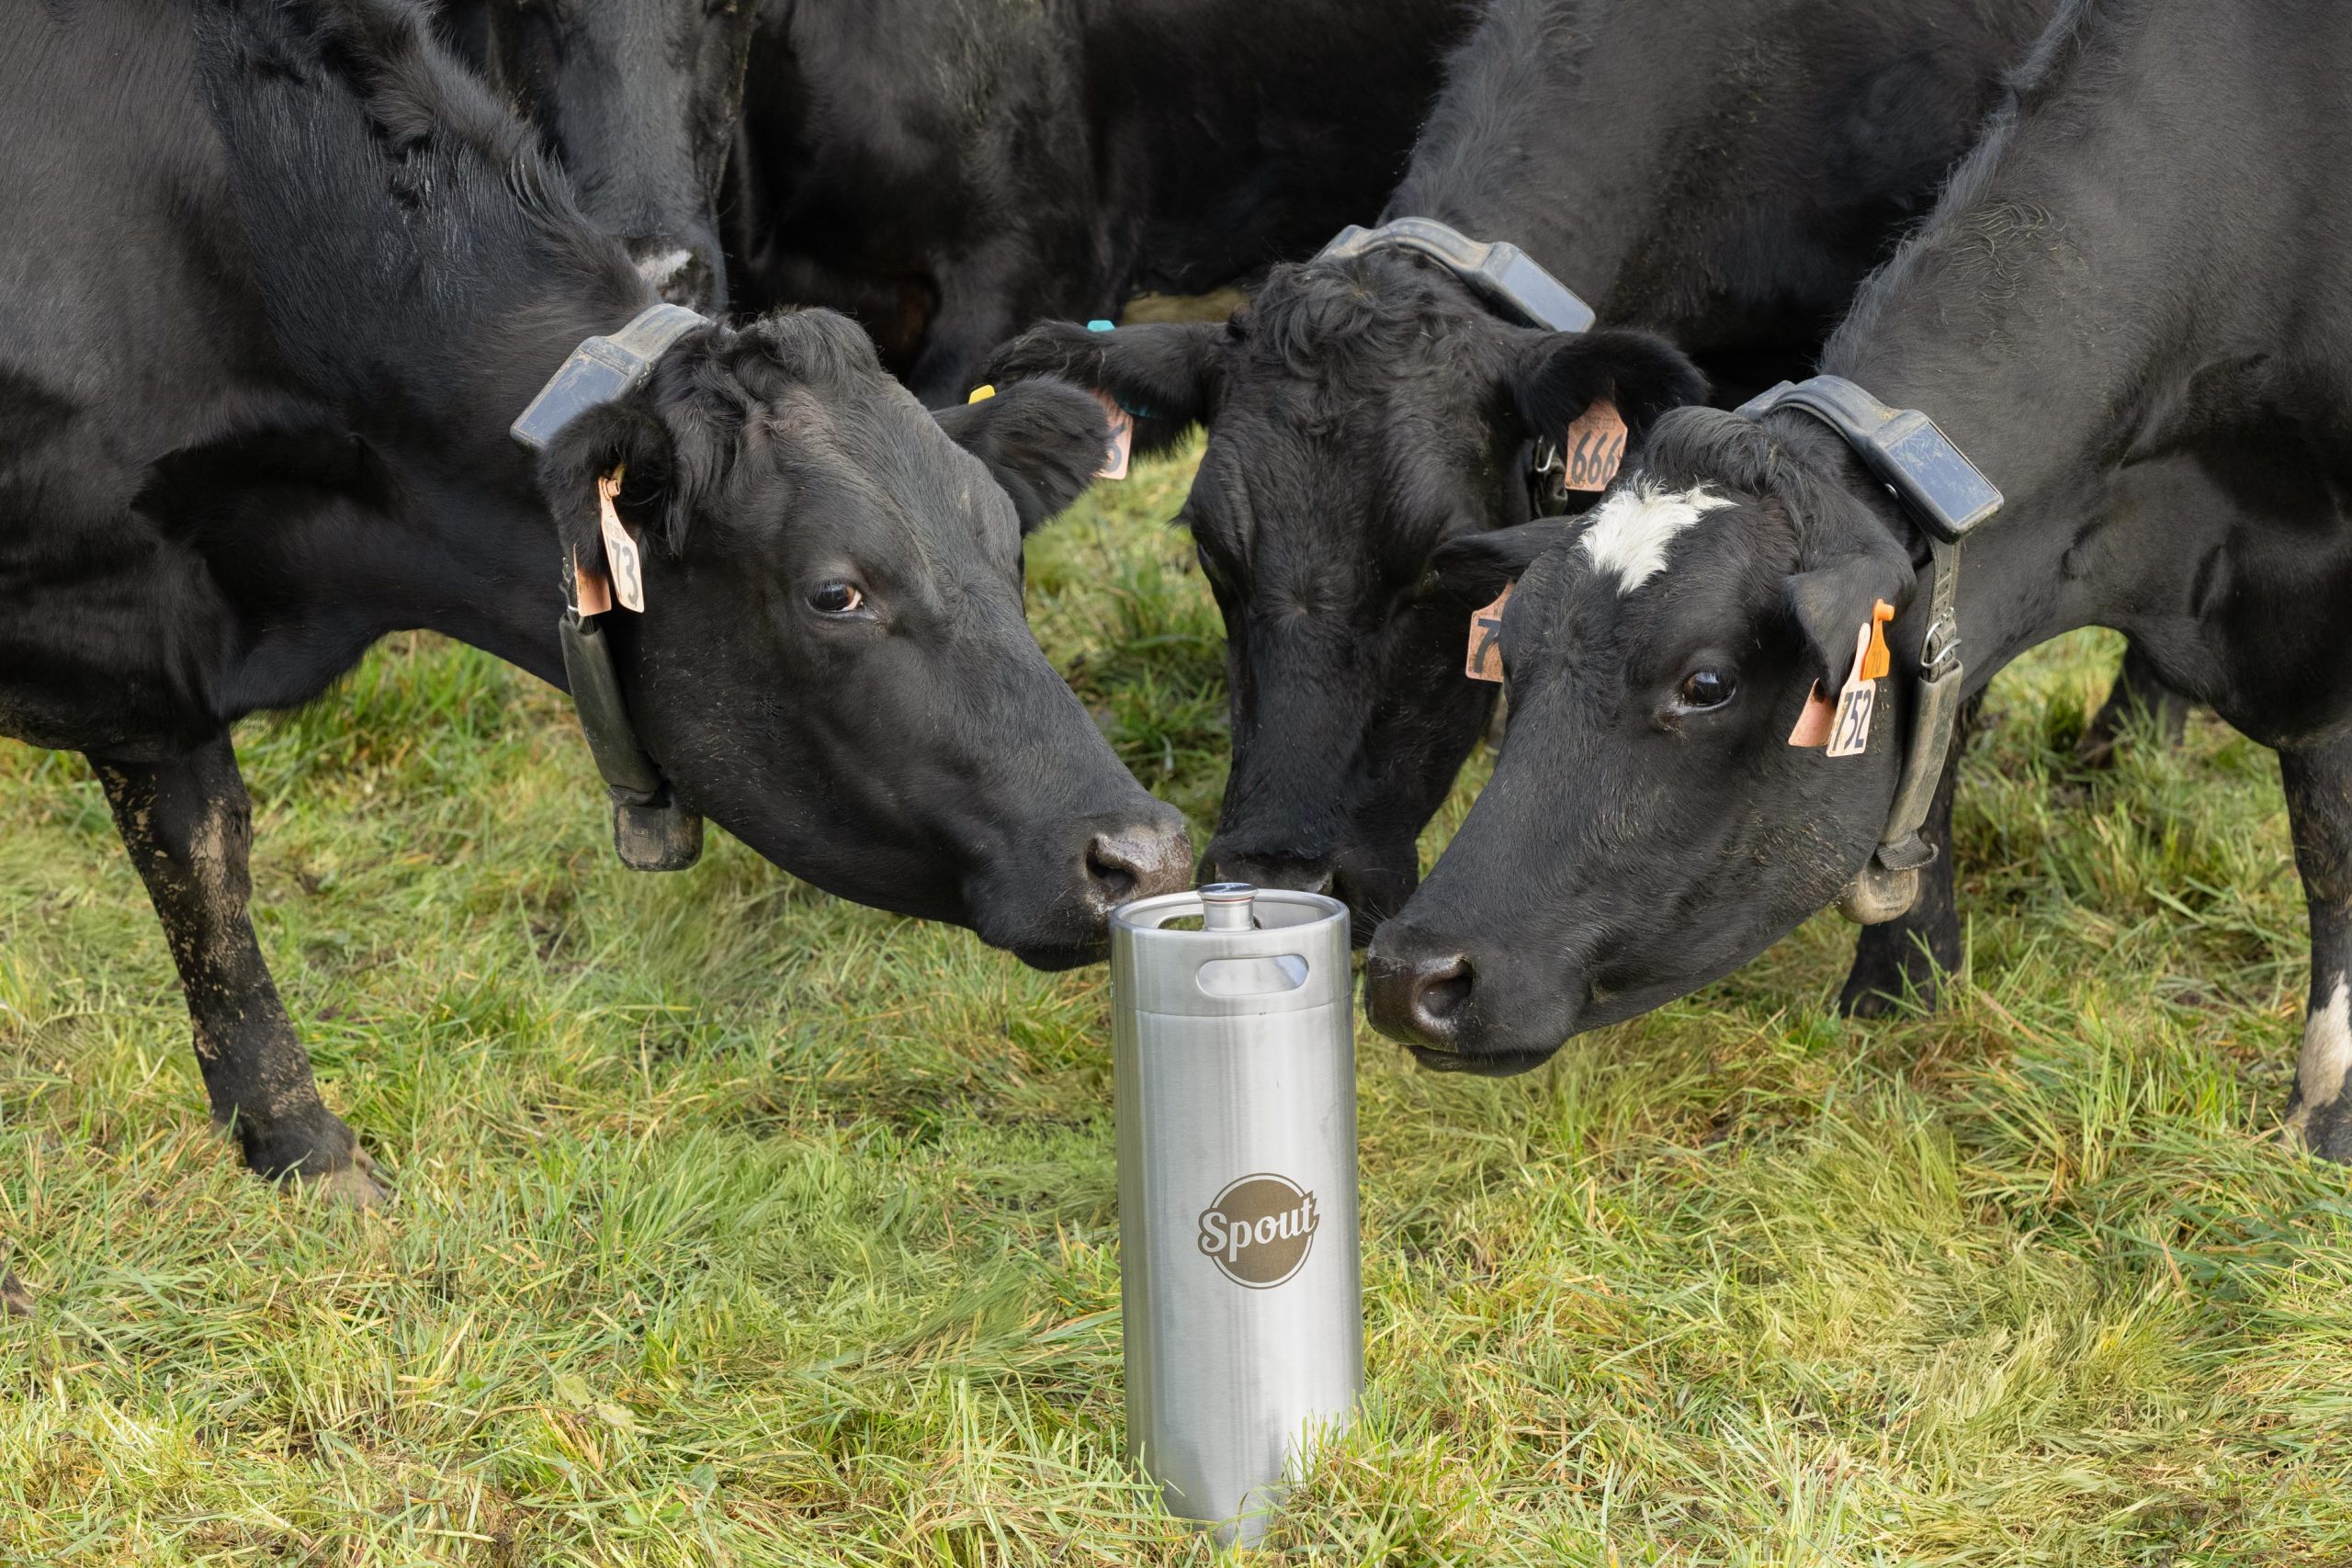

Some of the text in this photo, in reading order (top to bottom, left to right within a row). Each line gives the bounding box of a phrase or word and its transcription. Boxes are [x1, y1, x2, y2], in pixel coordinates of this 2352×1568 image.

[1571, 430, 1623, 486] 666
[610, 539, 639, 604] 73
[1832, 689, 1871, 752] 752
[1199, 1194, 1318, 1263] Spout
